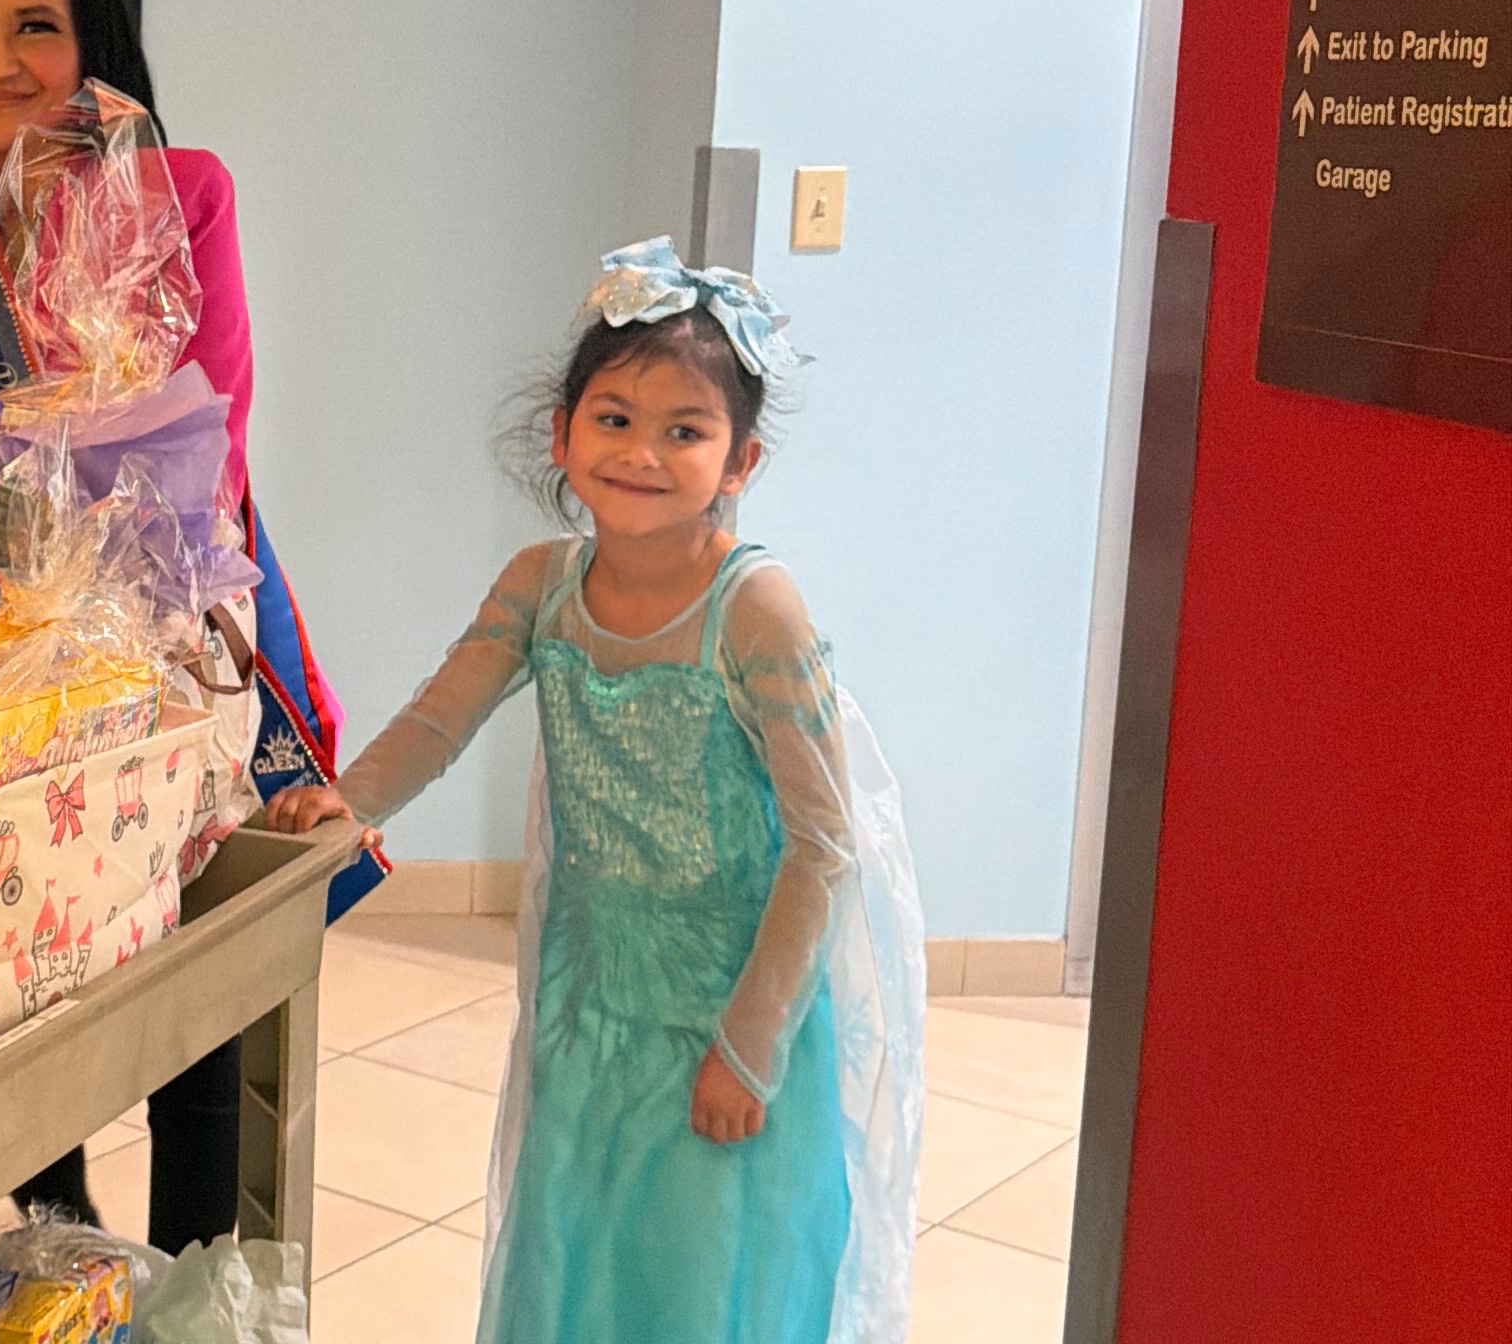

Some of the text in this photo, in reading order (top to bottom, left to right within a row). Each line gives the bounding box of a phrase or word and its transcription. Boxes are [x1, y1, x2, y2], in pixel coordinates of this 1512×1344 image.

[1327, 29, 1489, 68] Exit to Parking
[1320, 96, 1395, 126] Patient
[1316, 159, 1391, 198] Garage
